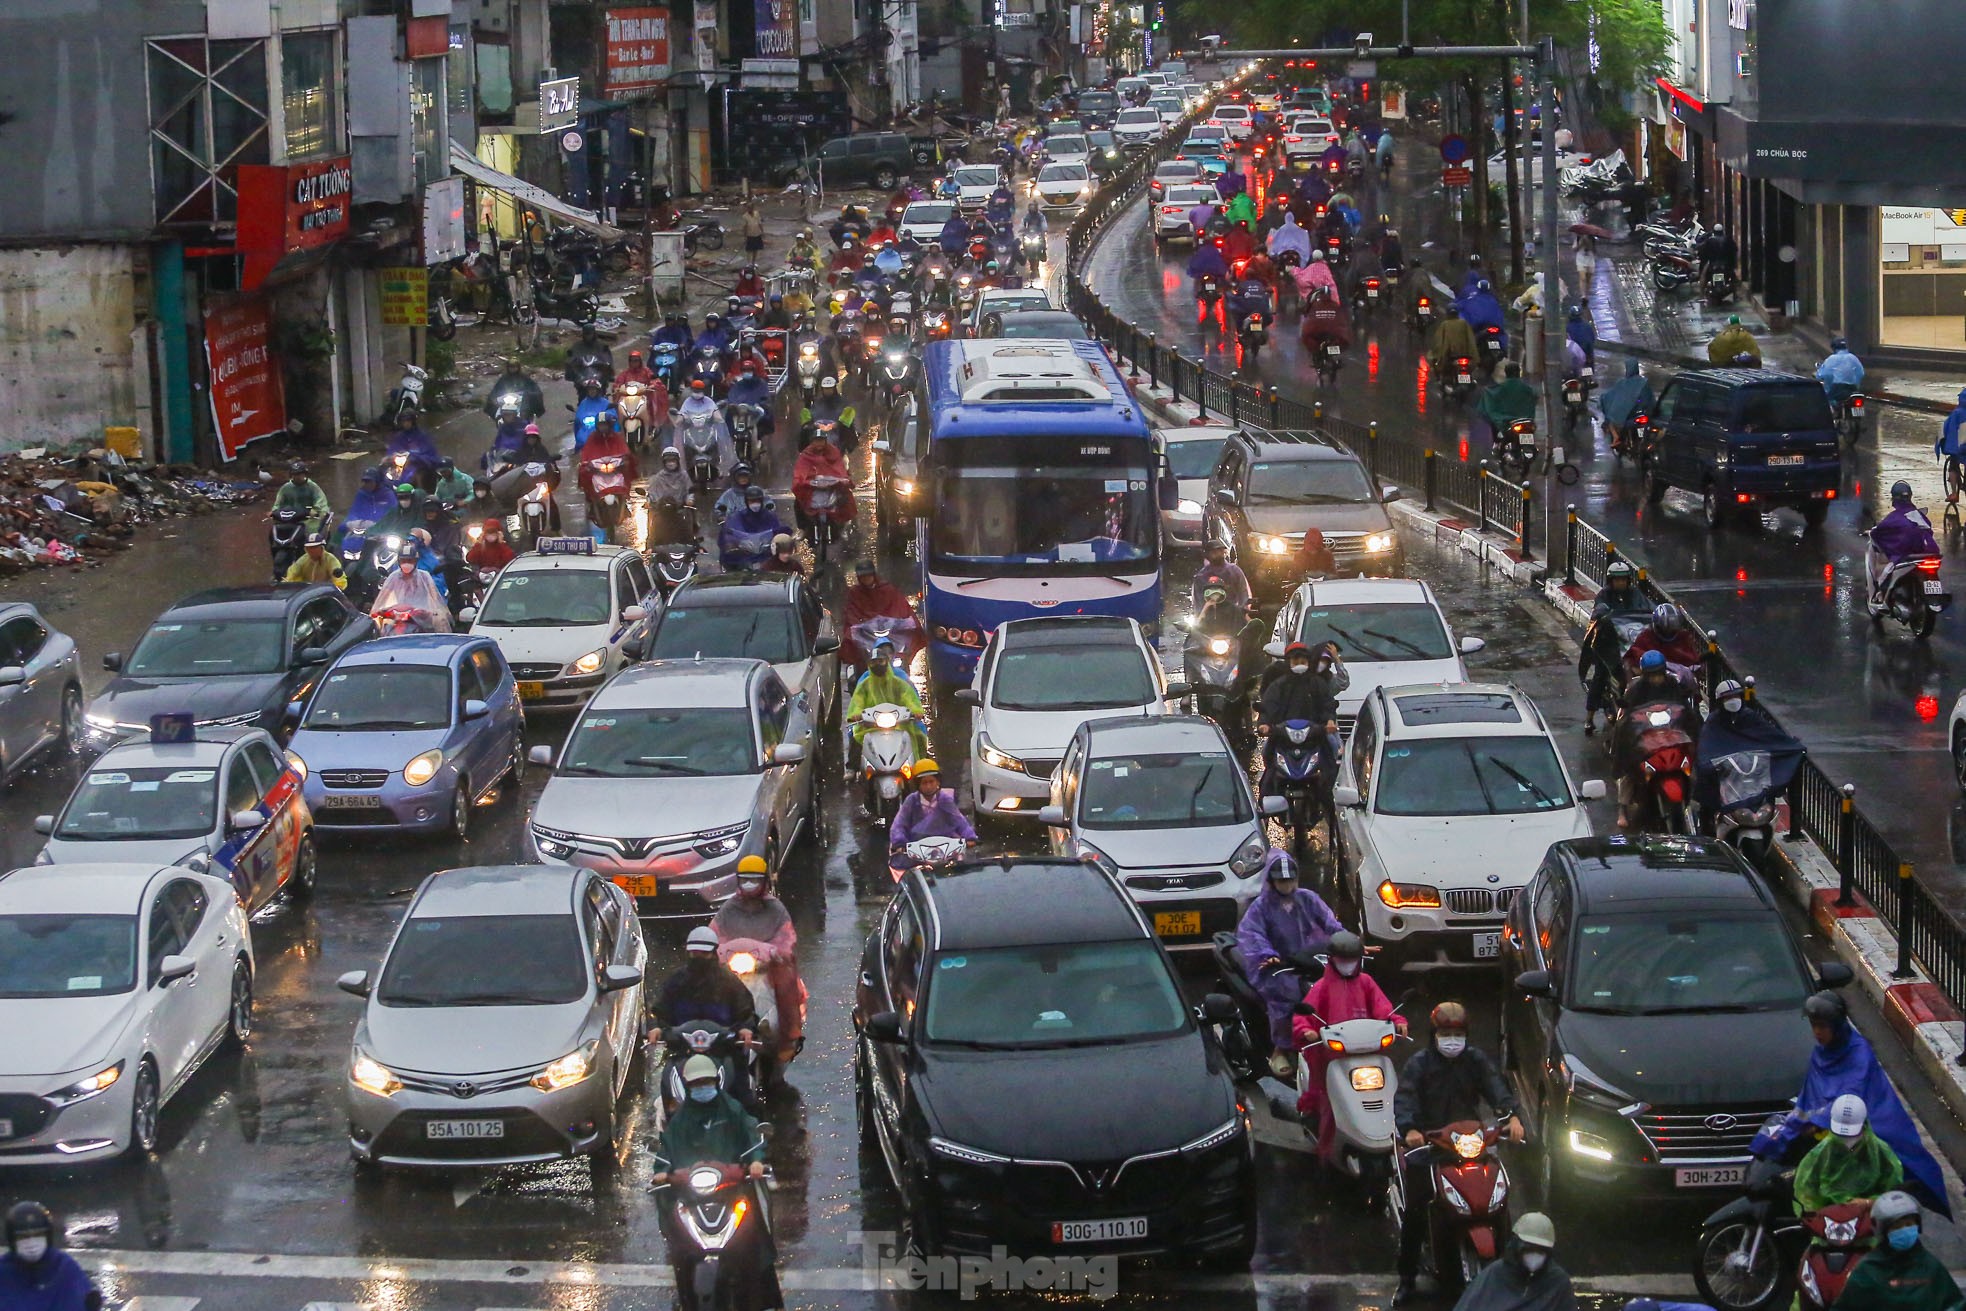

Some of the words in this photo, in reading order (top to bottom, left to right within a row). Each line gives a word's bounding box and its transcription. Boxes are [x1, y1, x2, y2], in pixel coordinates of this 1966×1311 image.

[1881, 211, 1912, 219] MacBook
[1914, 211, 1923, 219] Air
[554, 541, 565, 551] SAO
[1168, 913, 1188, 924] 30E
[1486, 935, 1499, 945] 51
[1478, 946, 1499, 956] 873
[1683, 1170, 1743, 1184] 30H-233.
[1063, 1220, 1146, 1240] 30G-110.10
